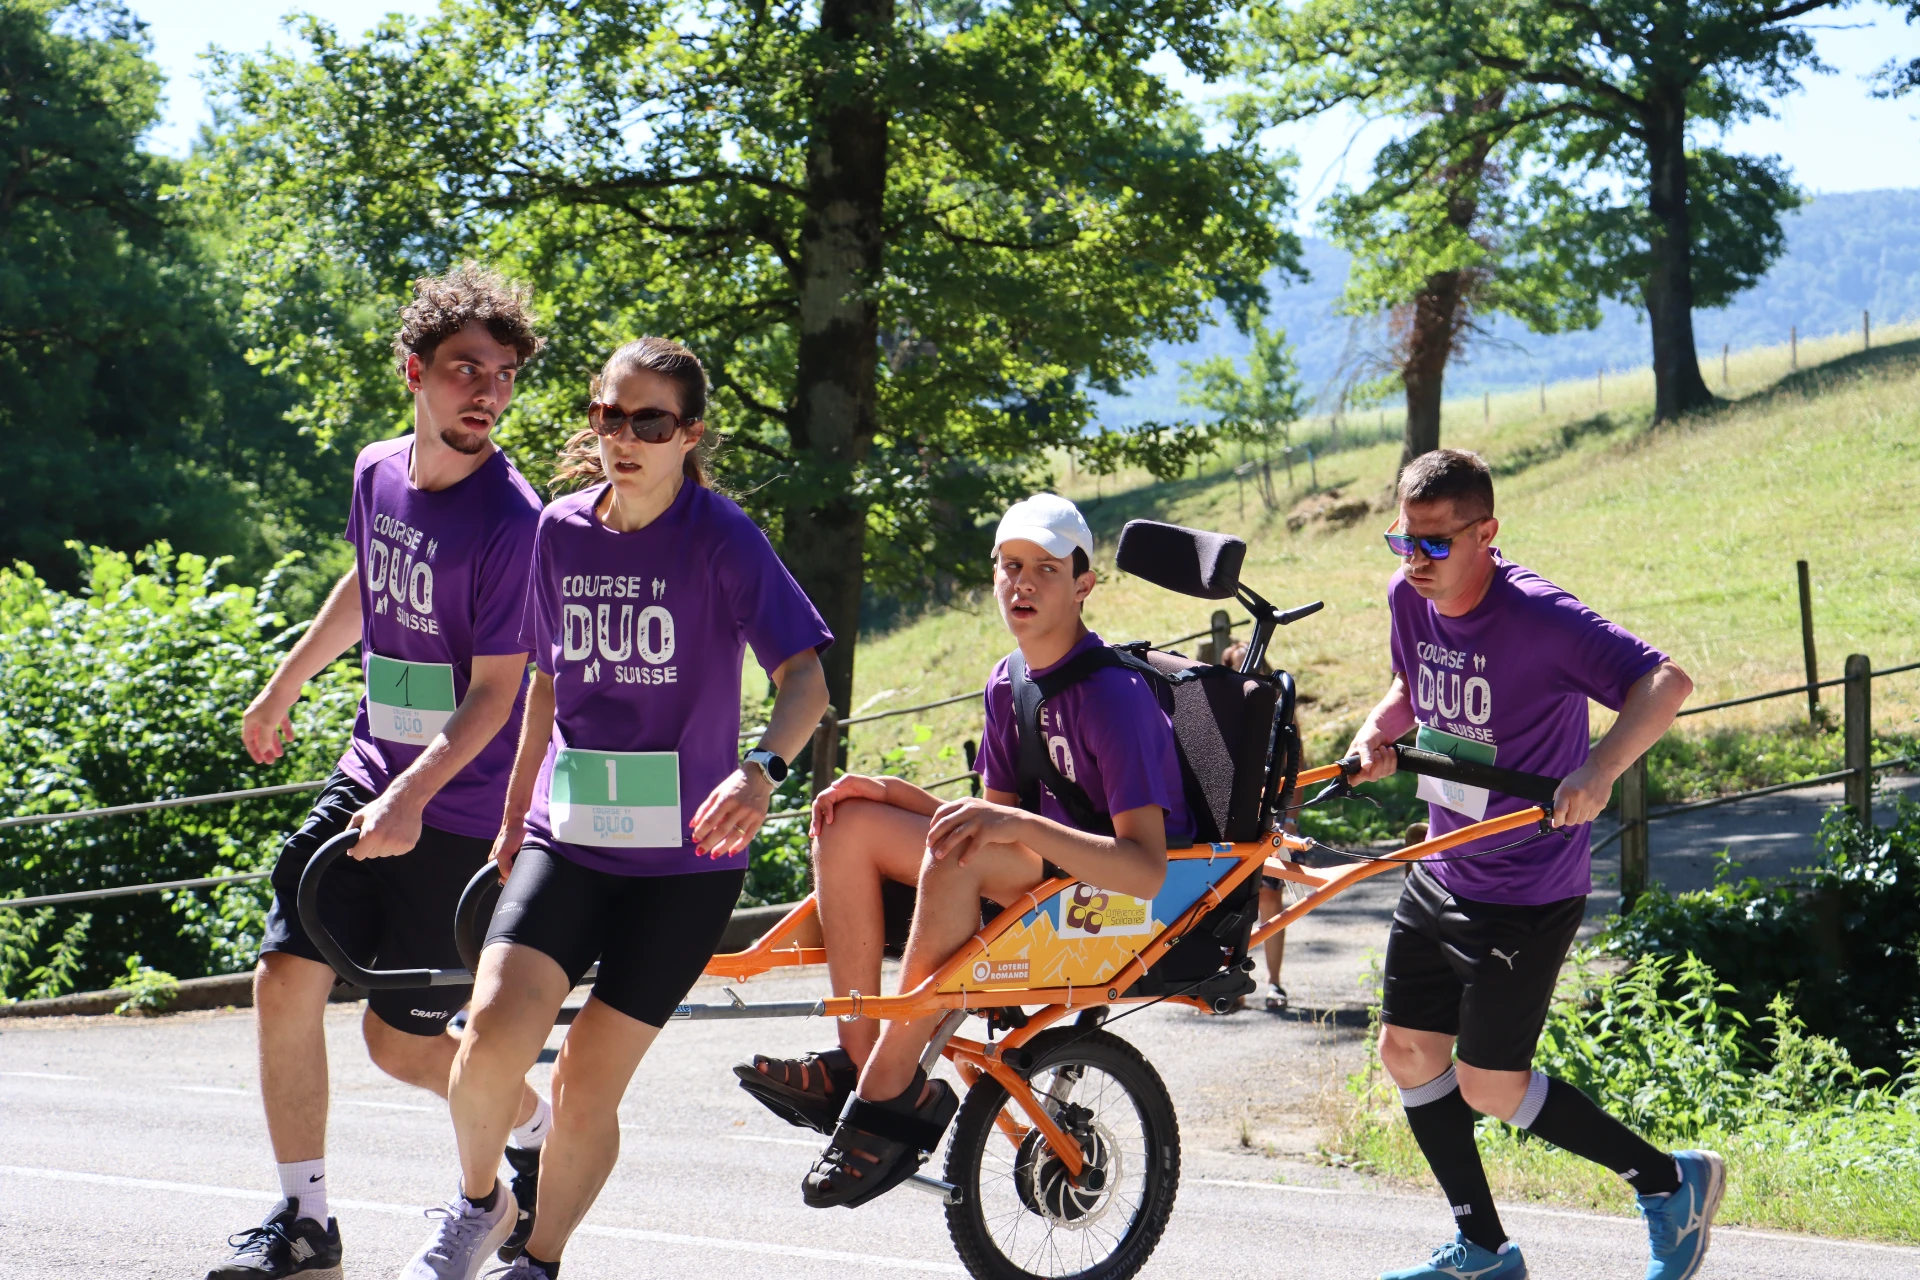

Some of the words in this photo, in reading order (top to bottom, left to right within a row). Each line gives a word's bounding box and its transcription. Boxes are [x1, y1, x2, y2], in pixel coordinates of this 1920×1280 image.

[374, 513, 424, 551] COURSE
[367, 538, 434, 615] DUO
[562, 575, 641, 598] COURSE
[396, 606, 439, 636] SUISSE
[563, 604, 675, 665] DUO
[1417, 641, 1466, 669] COURSE
[395, 666, 412, 707] 1
[615, 665, 677, 685] SUISSE
[1417, 663, 1492, 725] DUO
[393, 715, 423, 734] DUO
[1446, 723, 1494, 743] SUISSE
[605, 759, 617, 801] 1
[593, 815, 634, 834] DUO
[1110, 917, 1145, 926] Solidaires
[990, 971, 1029, 980] ROMANDE
[998, 962, 1029, 971] LOTERIE
[410, 1008, 443, 1019] CRAFT
